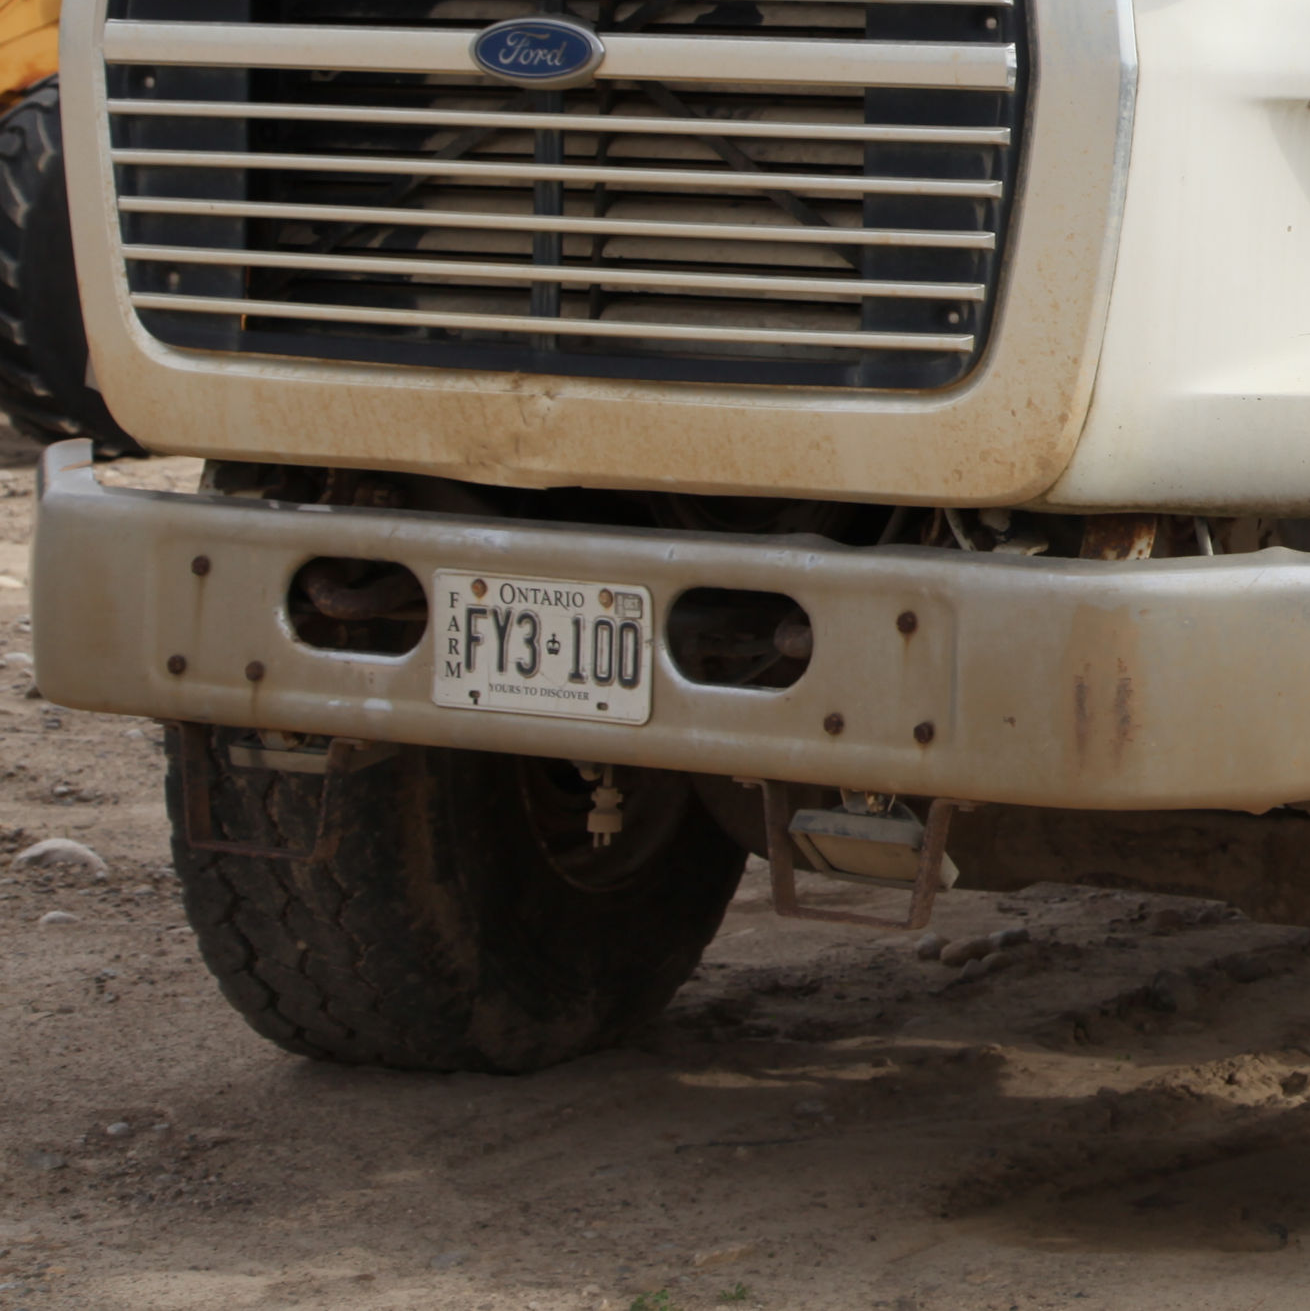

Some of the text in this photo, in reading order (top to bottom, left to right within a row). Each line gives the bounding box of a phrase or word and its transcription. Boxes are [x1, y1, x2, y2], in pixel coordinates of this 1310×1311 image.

[499, 31, 567, 66] Ford
[500, 583, 585, 610] ONTARIO
[445, 591, 462, 679] FARM
[465, 605, 641, 690] FY3 100
[489, 683, 589, 700] YOURS TO DISCOVER
